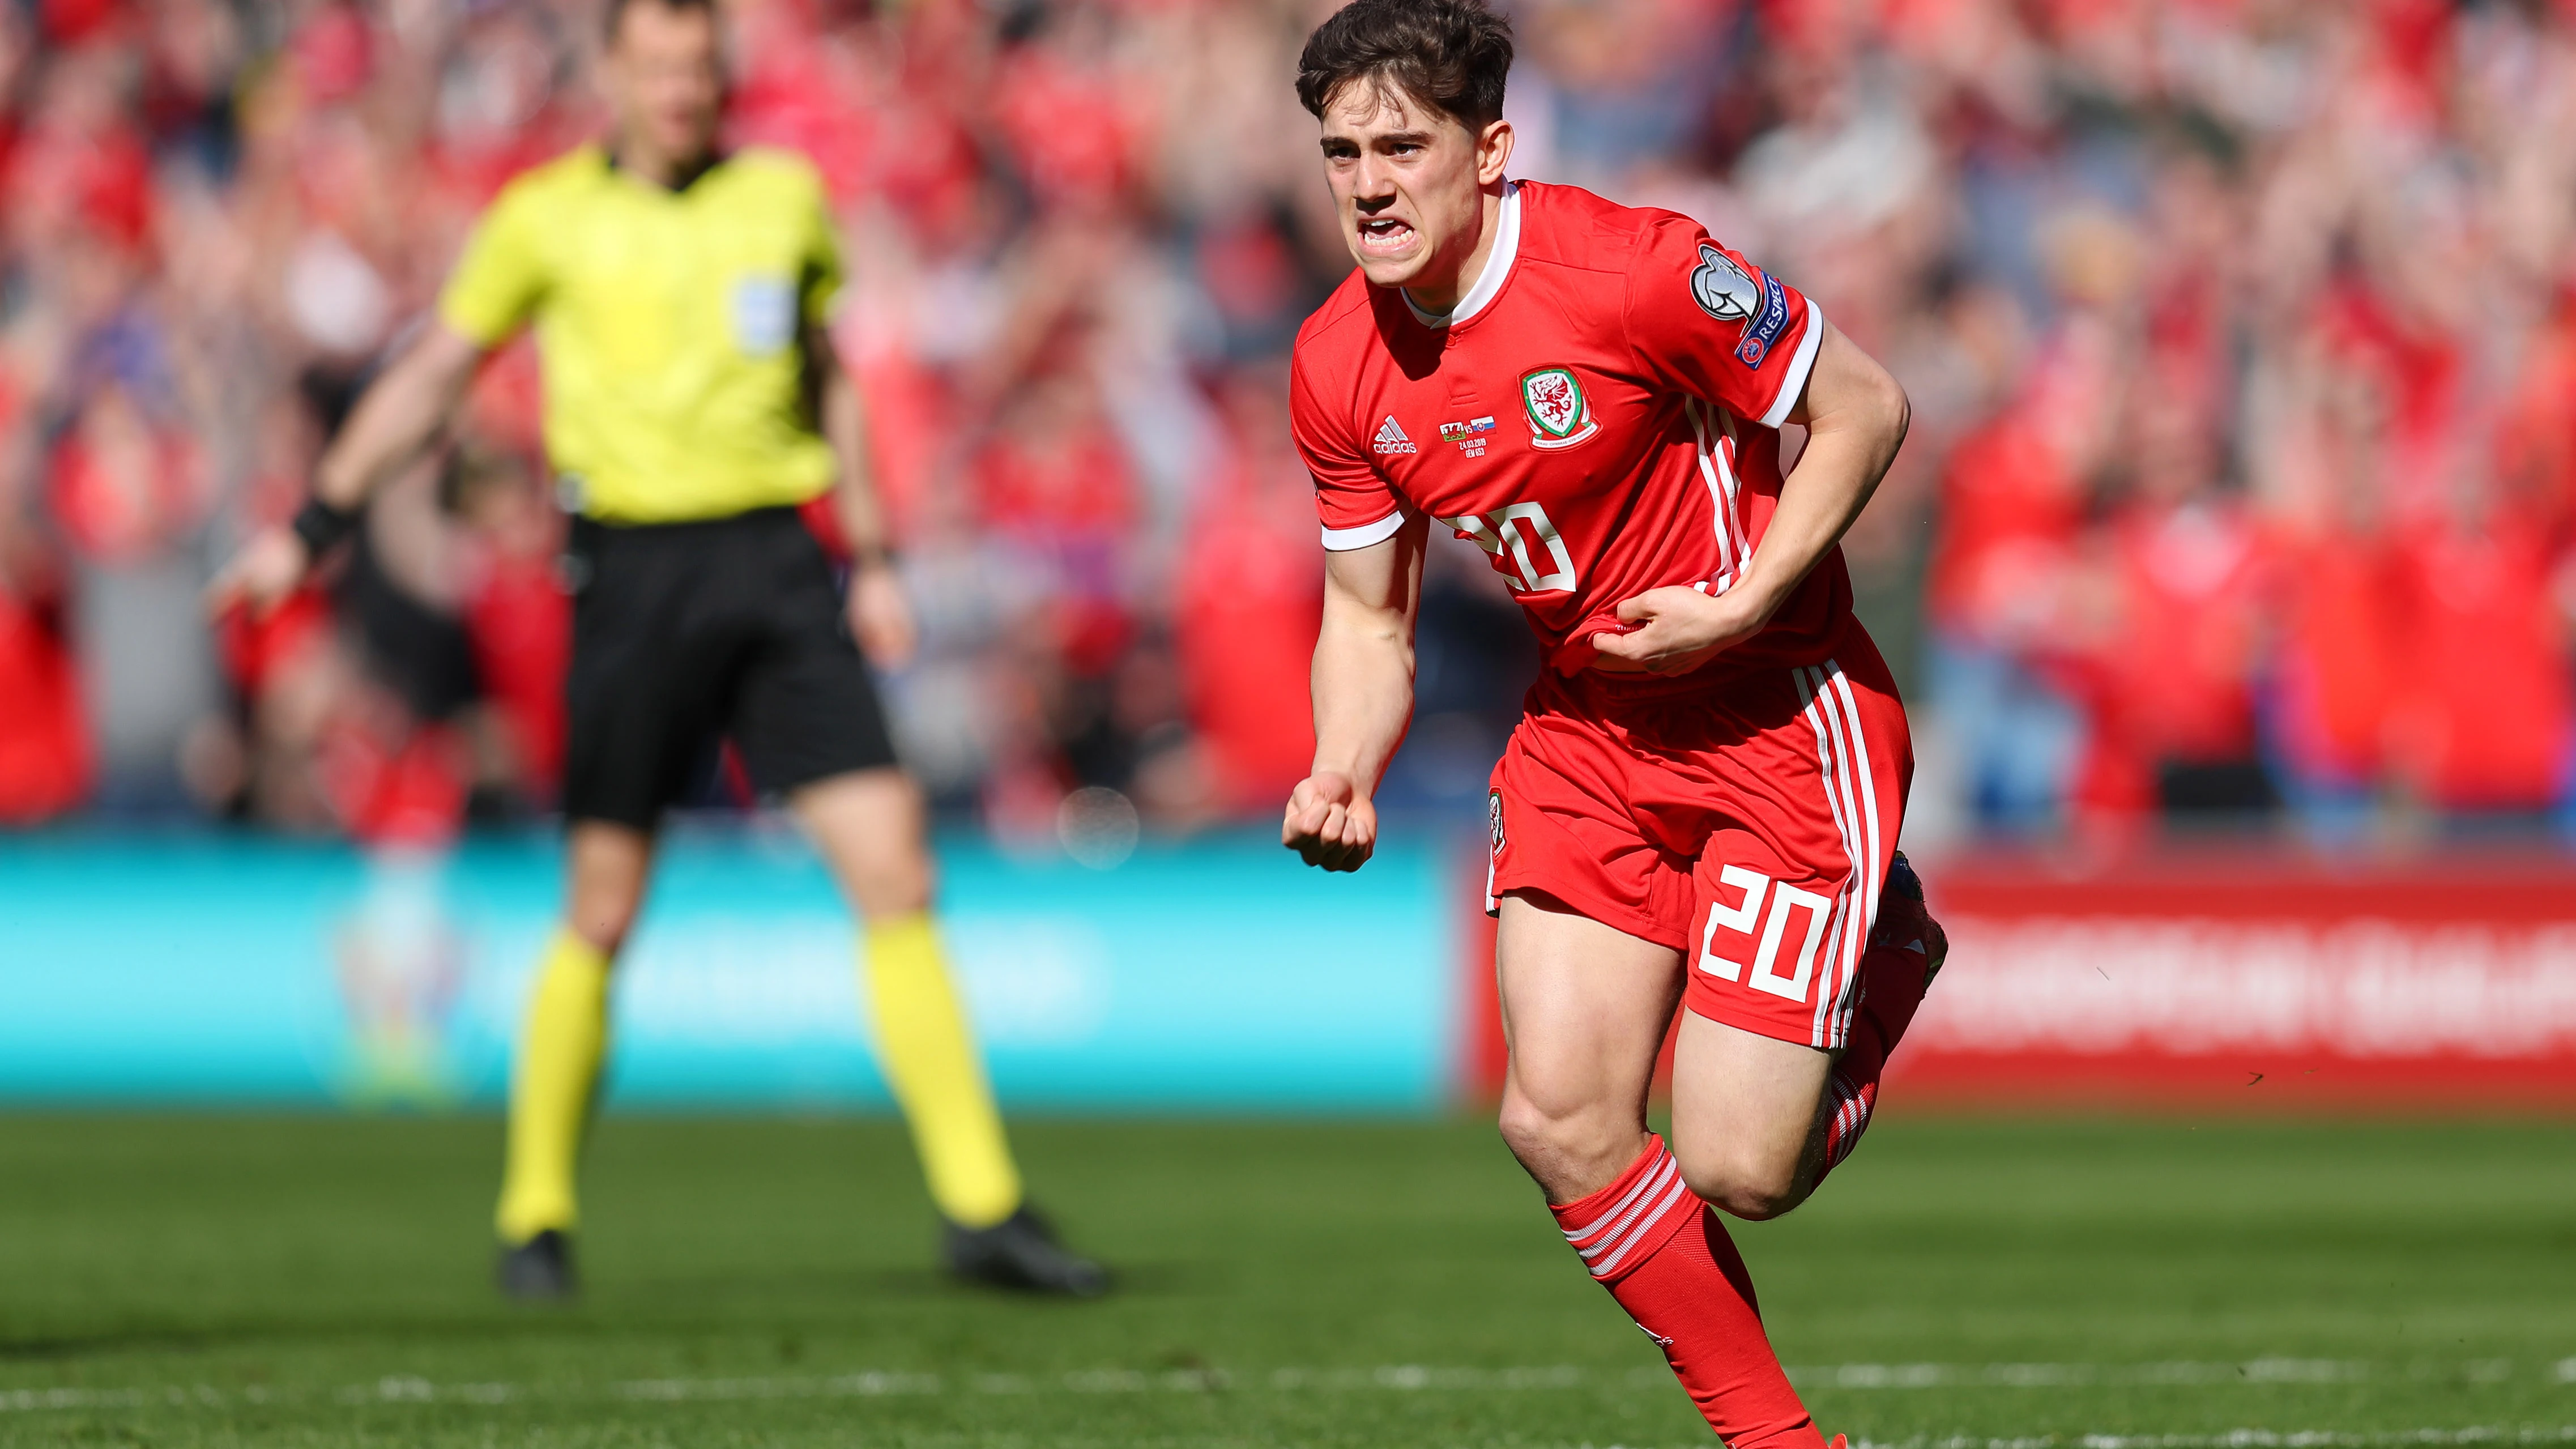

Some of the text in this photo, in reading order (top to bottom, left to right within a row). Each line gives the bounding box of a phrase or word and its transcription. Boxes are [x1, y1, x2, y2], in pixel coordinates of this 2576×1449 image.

[1759, 276, 1783, 340] RESPECT
[1464, 425, 1473, 434] VS
[1374, 440, 1417, 454] adidas
[1458, 437, 1487, 450] 24.03.2019
[1698, 863, 1832, 1004] 20
